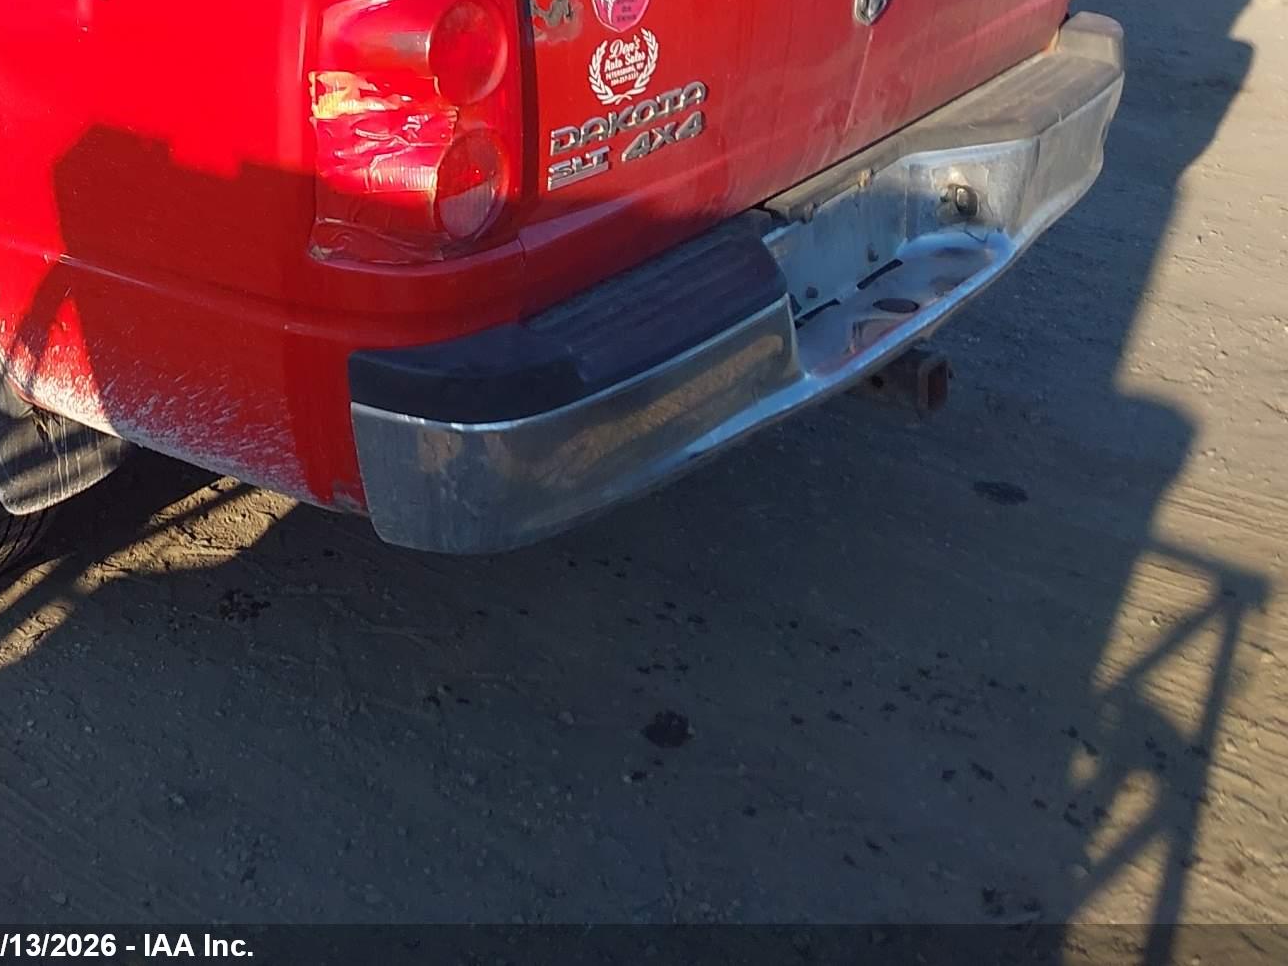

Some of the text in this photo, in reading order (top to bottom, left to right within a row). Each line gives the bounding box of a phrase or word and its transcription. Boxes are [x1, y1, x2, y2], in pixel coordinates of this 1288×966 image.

[604, 50, 646, 73] Auto Sales
[551, 81, 707, 156] DAKOTA
[548, 145, 611, 181] SLT
